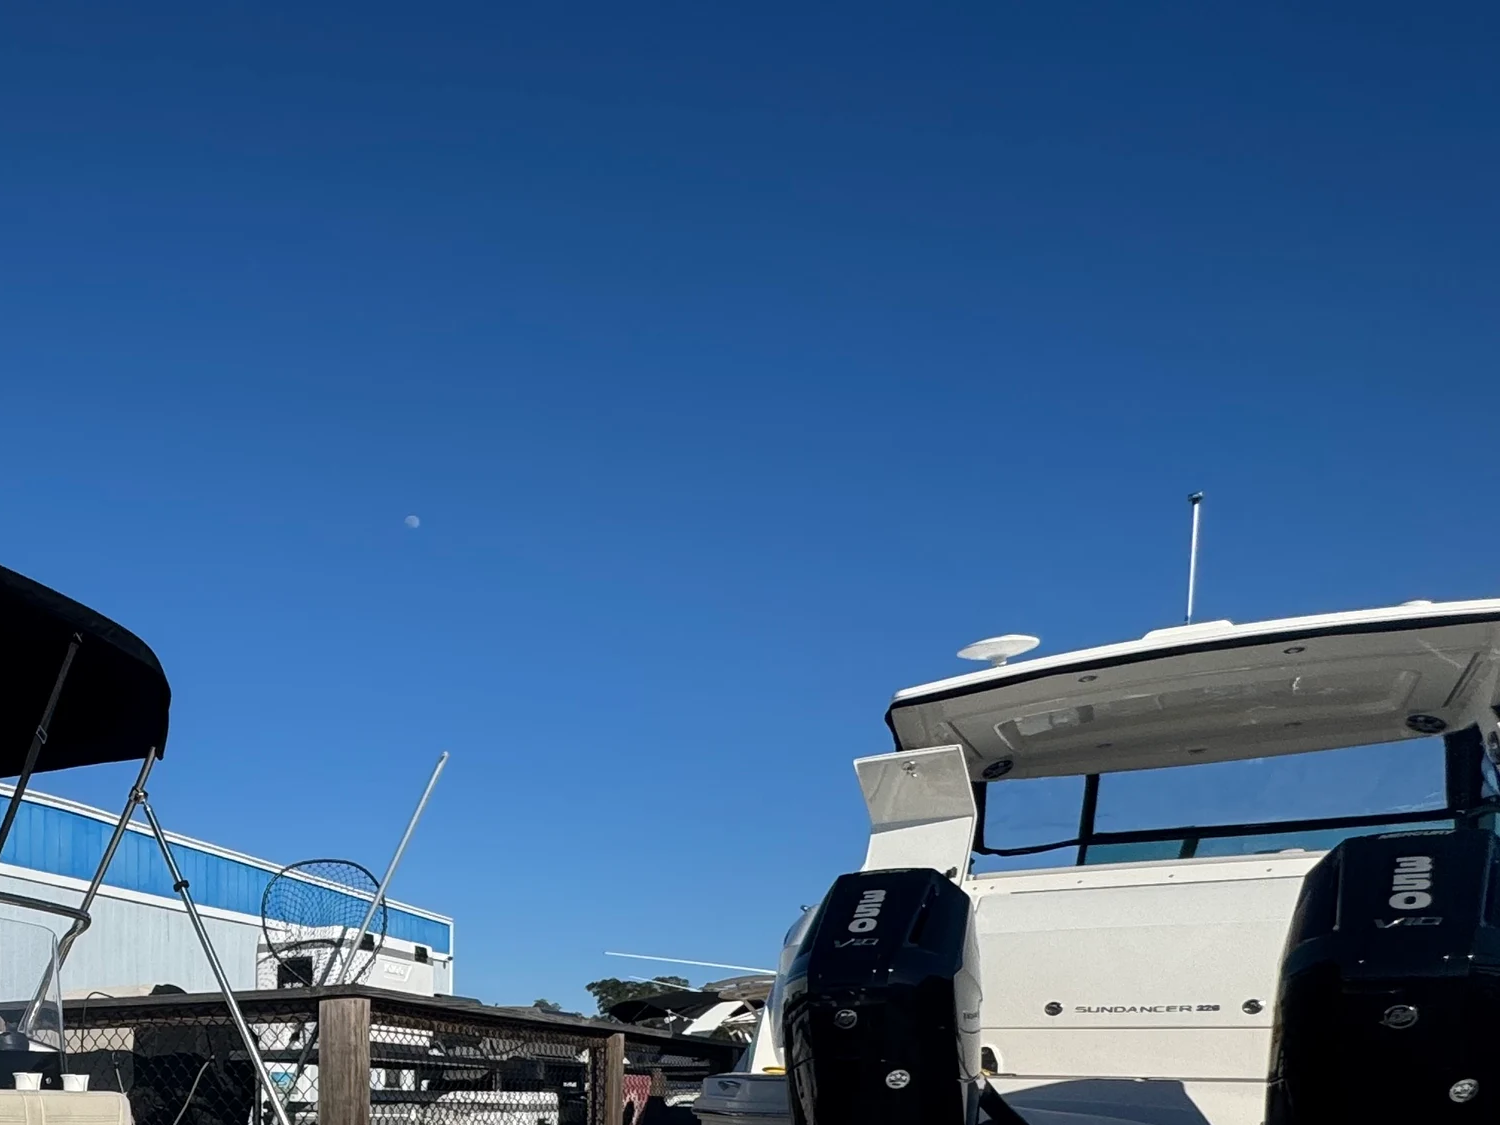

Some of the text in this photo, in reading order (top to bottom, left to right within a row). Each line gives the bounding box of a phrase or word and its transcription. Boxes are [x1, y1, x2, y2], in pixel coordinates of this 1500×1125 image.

[1389, 855, 1433, 910] 350
[847, 889, 887, 933] 350
[1074, 1004, 1193, 1014] SUNDANCER
